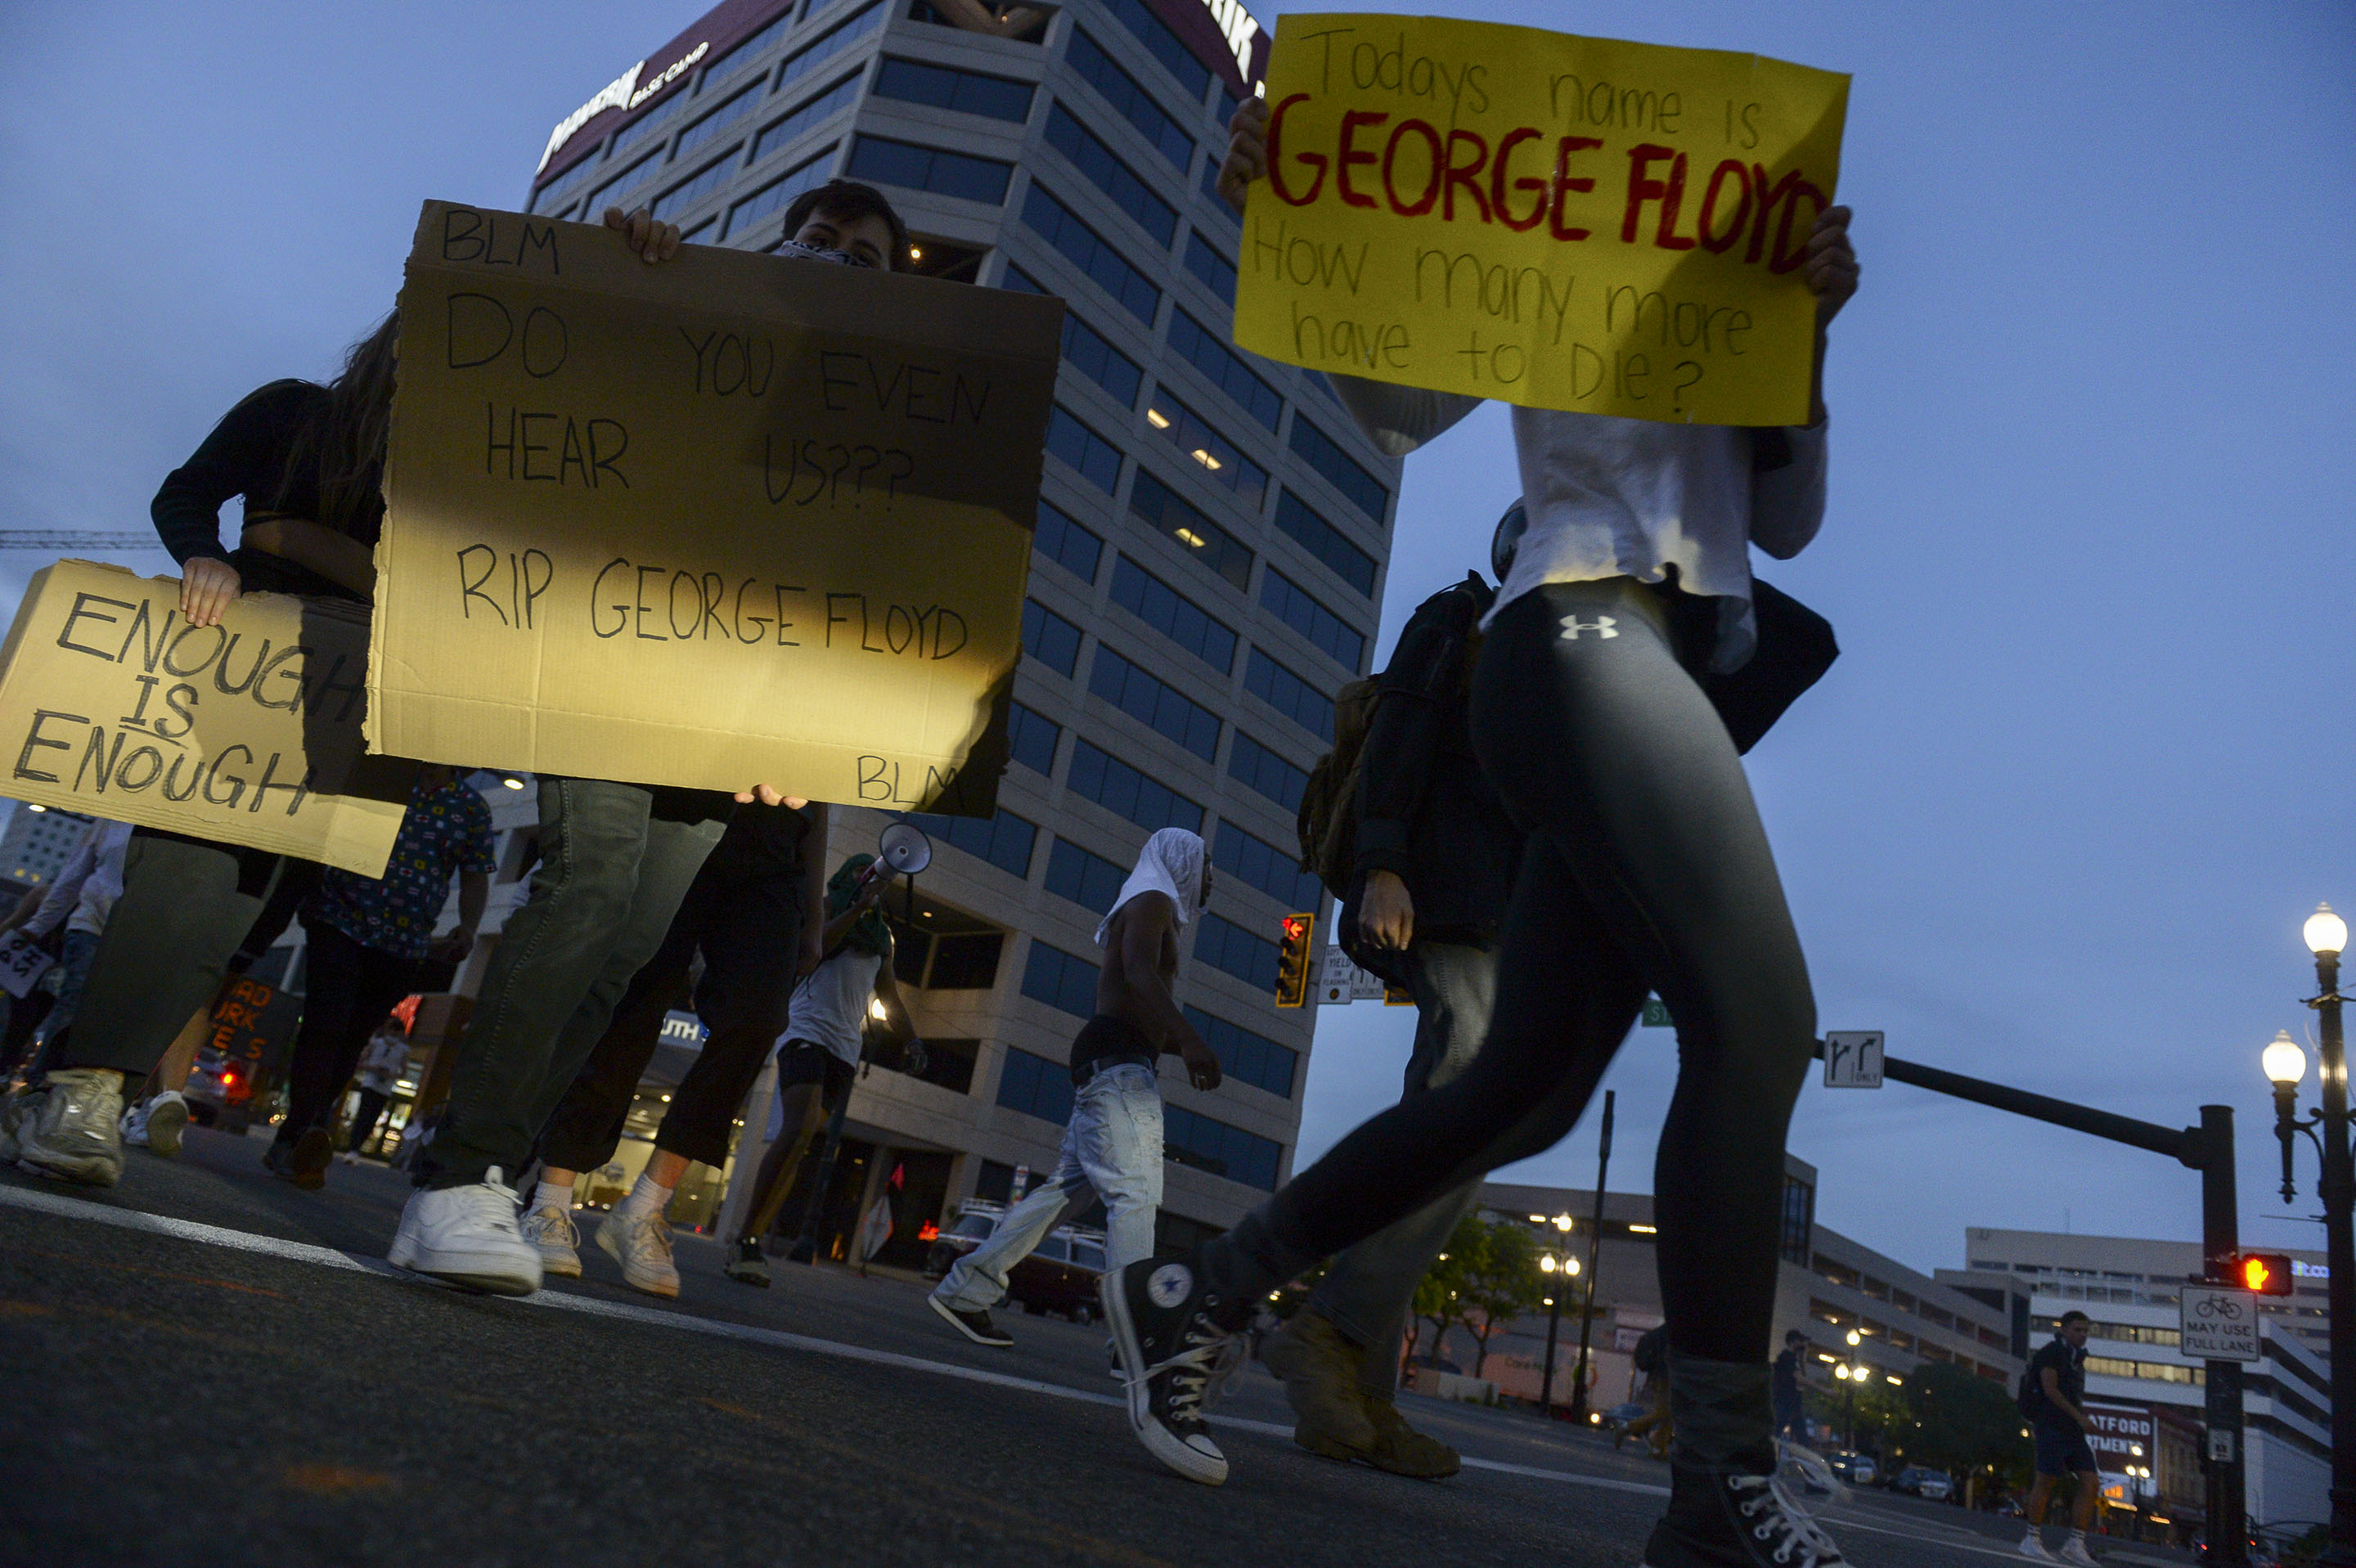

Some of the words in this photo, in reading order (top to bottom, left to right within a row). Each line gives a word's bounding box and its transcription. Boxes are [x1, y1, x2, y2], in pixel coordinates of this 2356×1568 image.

[1301, 29, 1489, 128] Todays
[1550, 74, 1681, 134] name
[1266, 93, 1604, 241] GEORGE
[1620, 142, 1829, 276] FLOYD
[442, 209, 560, 276] BLM
[1291, 299, 1412, 370] have
[1456, 329, 1526, 385] to
[1415, 246, 1575, 345] many
[1606, 283, 1753, 356] more
[447, 292, 569, 379] DO
[678, 327, 775, 398] YOU
[821, 350, 991, 427] EVEN
[486, 402, 630, 490] HEAR
[765, 434, 915, 513] US???
[456, 542, 555, 631] RIP
[590, 556, 809, 647] GEORGE
[824, 591, 969, 660] FLOYD
[56, 591, 366, 723] ENOUGH
[119, 674, 200, 738] IS
[13, 708, 315, 816] ENOUGH
[857, 754, 964, 810] BLM
[1329, 957, 1352, 968] YIELD
[1856, 1072, 1878, 1081] ONLY
[2186, 1337, 2216, 1350] FULL
[2221, 1341, 2255, 1354] LANE
[2187, 1322, 2219, 1334] MAY
[2223, 1324, 2251, 1337] USE
